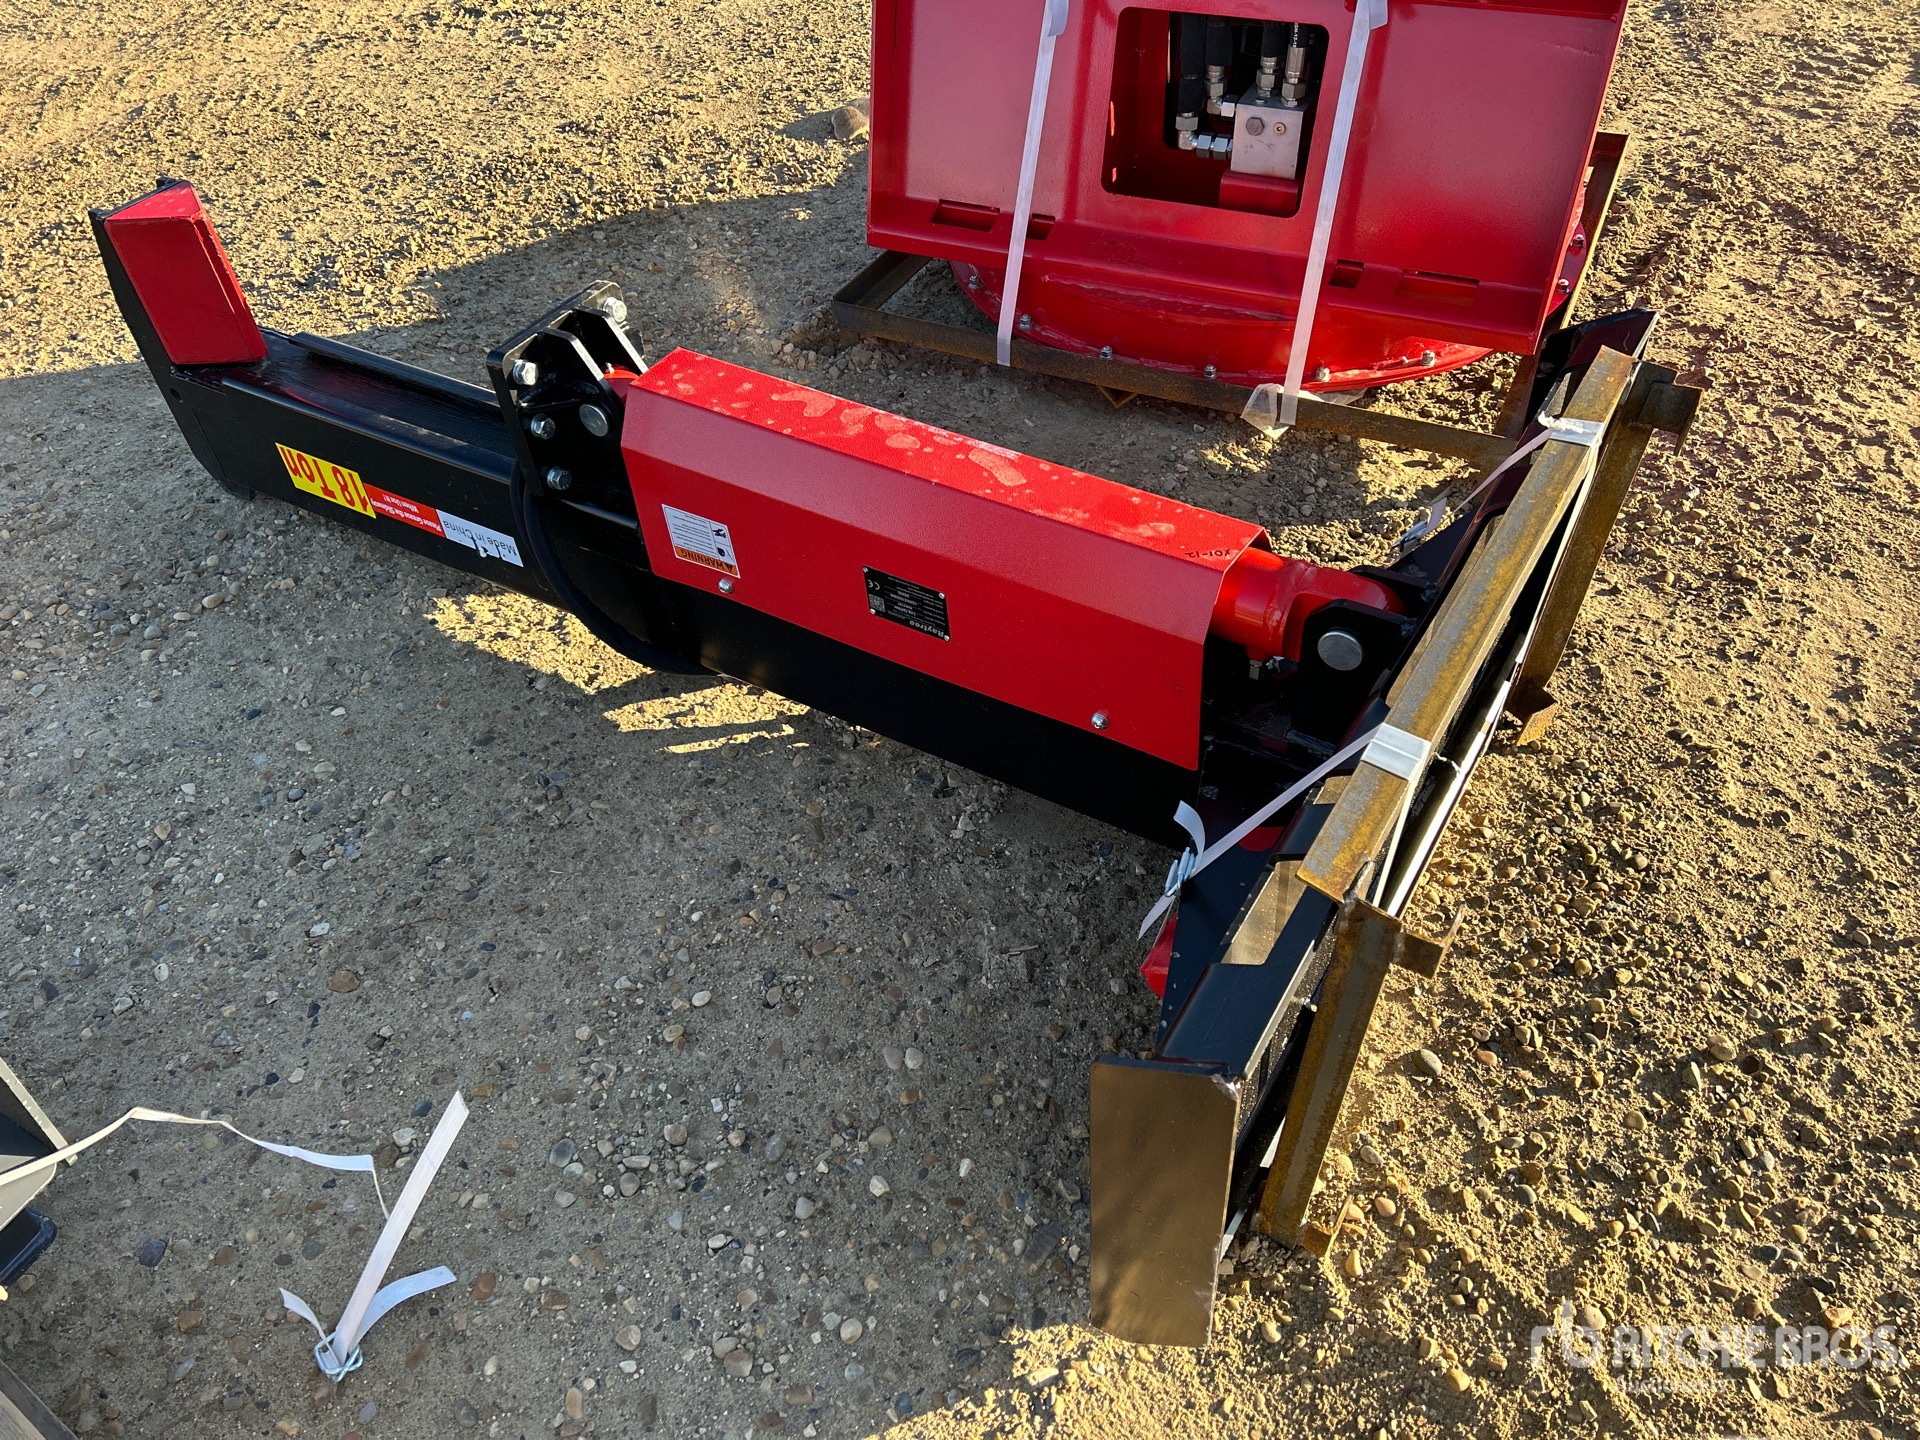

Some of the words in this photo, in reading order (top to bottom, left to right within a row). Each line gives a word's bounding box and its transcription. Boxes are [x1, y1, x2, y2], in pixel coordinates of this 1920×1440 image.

[280, 449, 338, 500] Ton
[332, 465, 368, 512] 18
[443, 520, 474, 540] China
[475, 533, 487, 544] in
[487, 537, 517, 556] Made
[681, 549, 724, 570] WARNING
